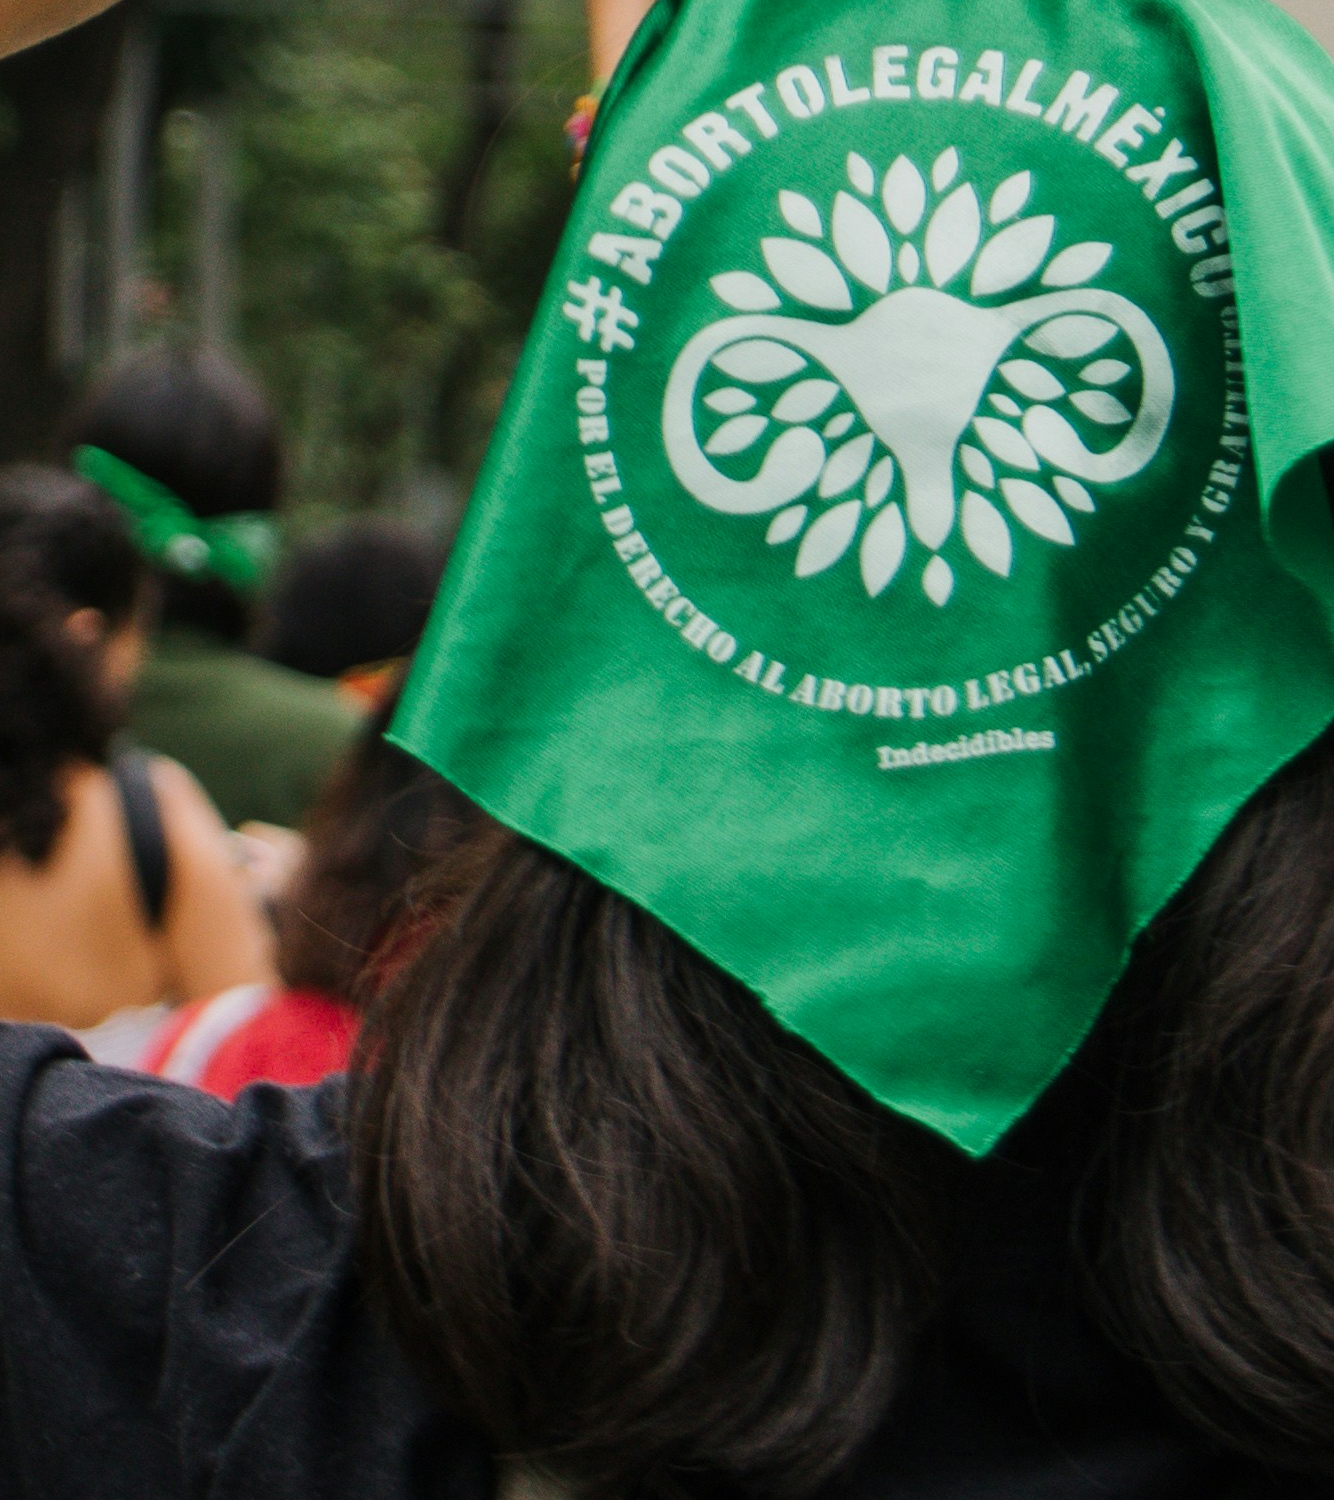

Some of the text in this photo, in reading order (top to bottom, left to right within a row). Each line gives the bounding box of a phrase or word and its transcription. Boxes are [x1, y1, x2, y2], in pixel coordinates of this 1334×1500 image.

[575, 358, 610, 446] POR
[584, 450, 623, 504] EL
[1184, 520, 1215, 544] Y
[599, 503, 738, 664] DERECHO
[1086, 544, 1199, 665] SEGURO
[733, 650, 787, 695] AL
[788, 672, 959, 720] ABORTO
[963, 648, 1093, 712] LEGAL,
[875, 726, 1056, 770] Indecidibles
